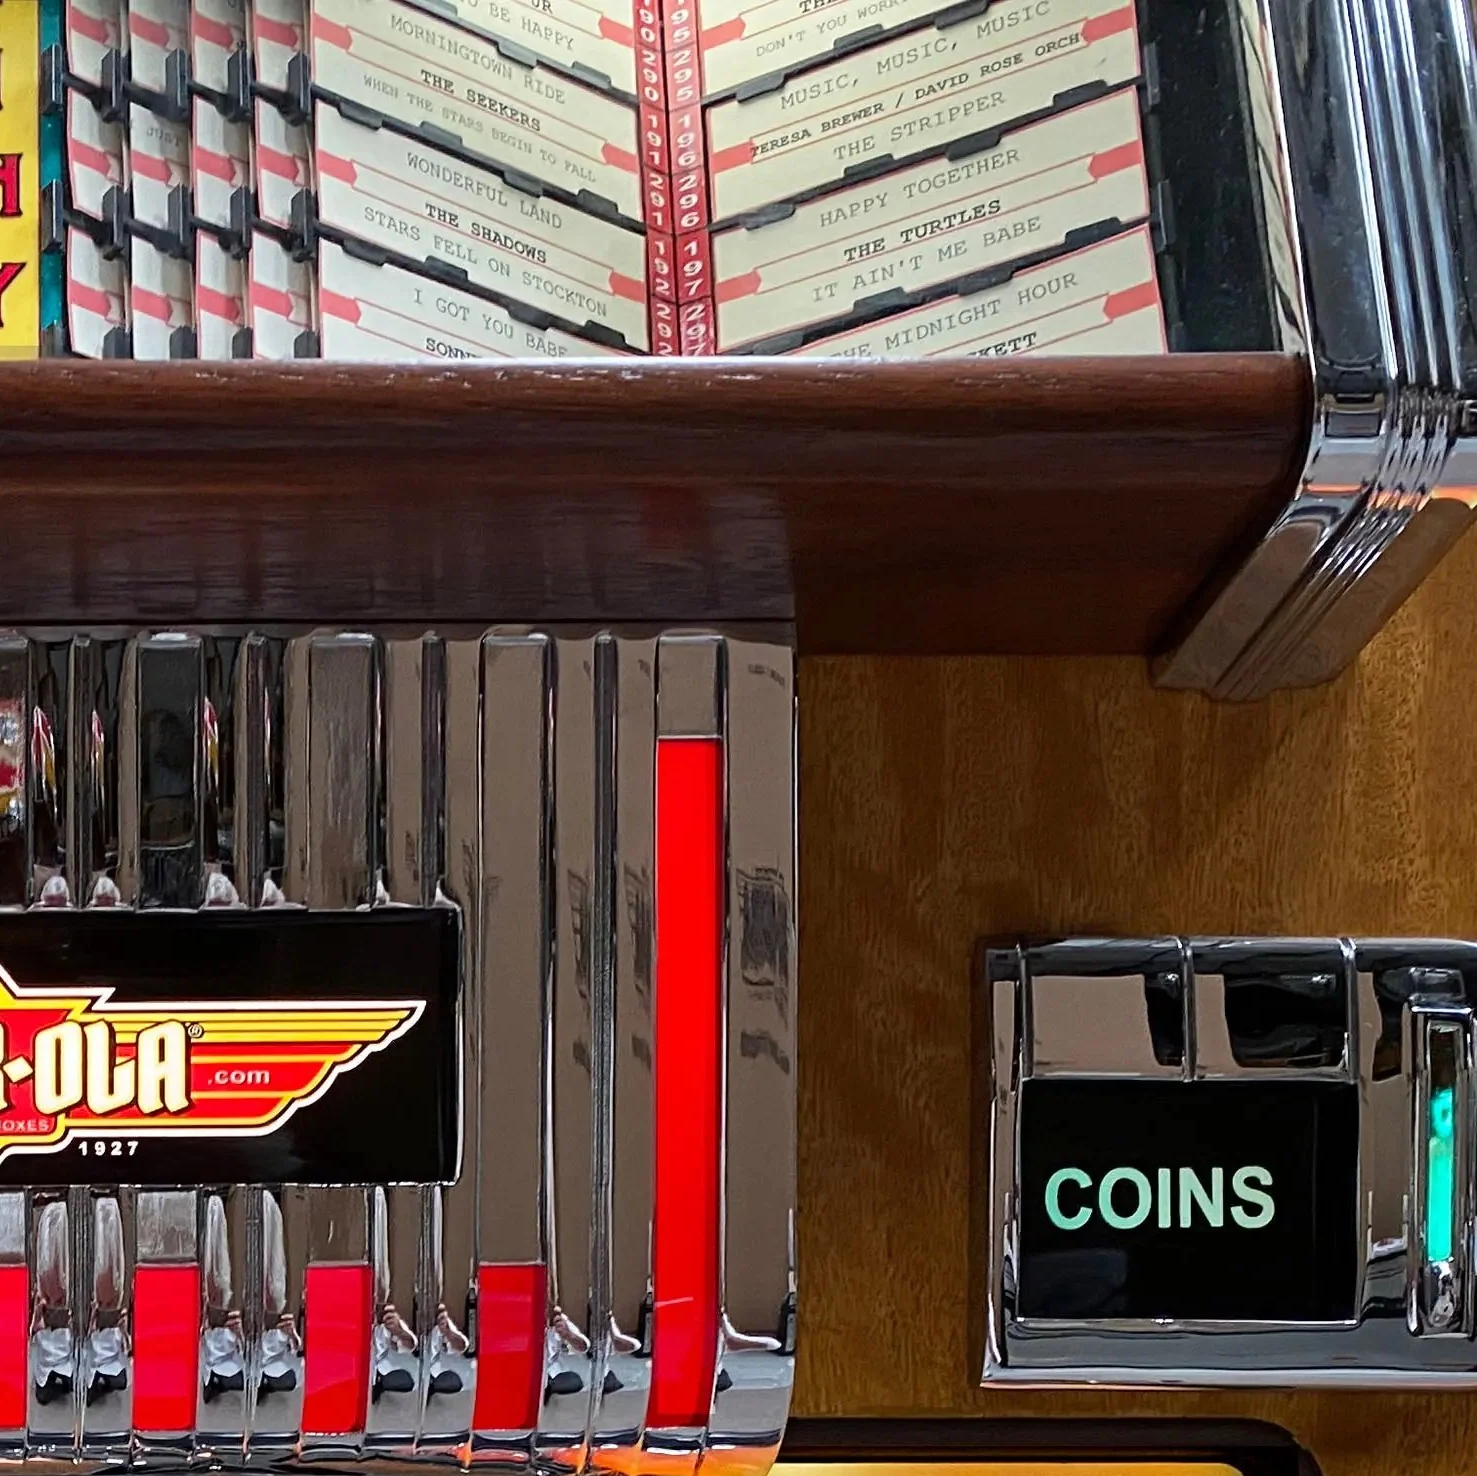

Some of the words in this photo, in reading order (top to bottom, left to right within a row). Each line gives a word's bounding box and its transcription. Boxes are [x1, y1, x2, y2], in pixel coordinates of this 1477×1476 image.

[391, 15, 513, 80] MORNINGTOWN
[524, 73, 566, 104] RIDE
[490, 3, 511, 23] BE
[521, 16, 574, 50] HAPPY
[756, 29, 806, 57] DON'T
[816, 15, 847, 35] YOU
[780, 73, 860, 110] MUSIC,
[877, 37, 957, 75] MUSIC,
[977, 1, 1051, 40] MUSIC
[363, 74, 399, 98] WHEN
[407, 92, 434, 112] THE
[442, 109, 484, 134] STARS
[491, 128, 532, 154] BEGIN
[540, 149, 556, 165] TO
[564, 160, 596, 182] FALL
[421, 69, 454, 94] THE
[466, 90, 541, 132] SEEKERS
[751, 130, 812, 158] TERESA
[821, 103, 885, 133] BREWER
[915, 73, 969, 100] DAVID
[980, 53, 1023, 75] ROSE
[1035, 33, 1080, 57] ORCH
[834, 136, 876, 160] THE
[890, 91, 1005, 142] STRIPPER
[407, 152, 508, 207] WONDERFUL
[520, 200, 563, 229] LAND
[820, 192, 888, 228] HAPPY
[903, 149, 1021, 199] TOGETHER
[364, 206, 421, 241] STARS
[434, 235, 478, 265] FELL
[489, 257, 511, 278] ON
[523, 271, 607, 317] STOCKTON
[425, 202, 459, 228] THE
[471, 222, 547, 263] SHADOWS
[813, 282, 838, 302] IT
[852, 254, 924, 290] AIN'T
[937, 240, 968, 262] ME
[983, 216, 1042, 248] BABE
[844, 238, 886, 262] THE
[900, 199, 1002, 243] TURTLES
[413, 288, 423, 305] I
[436, 297, 471, 321] GOT
[482, 314, 514, 339] YOU
[526, 332, 569, 357] BABE
[885, 299, 1001, 350] MIDNIGHT
[1018, 273, 1078, 306] HOUR
[968, 332, 1037, 357] KETT
[207, 1069, 271, 1086] .com
[78, 1140, 139, 1156] 1927
[1044, 1166, 1276, 1230] COINS
